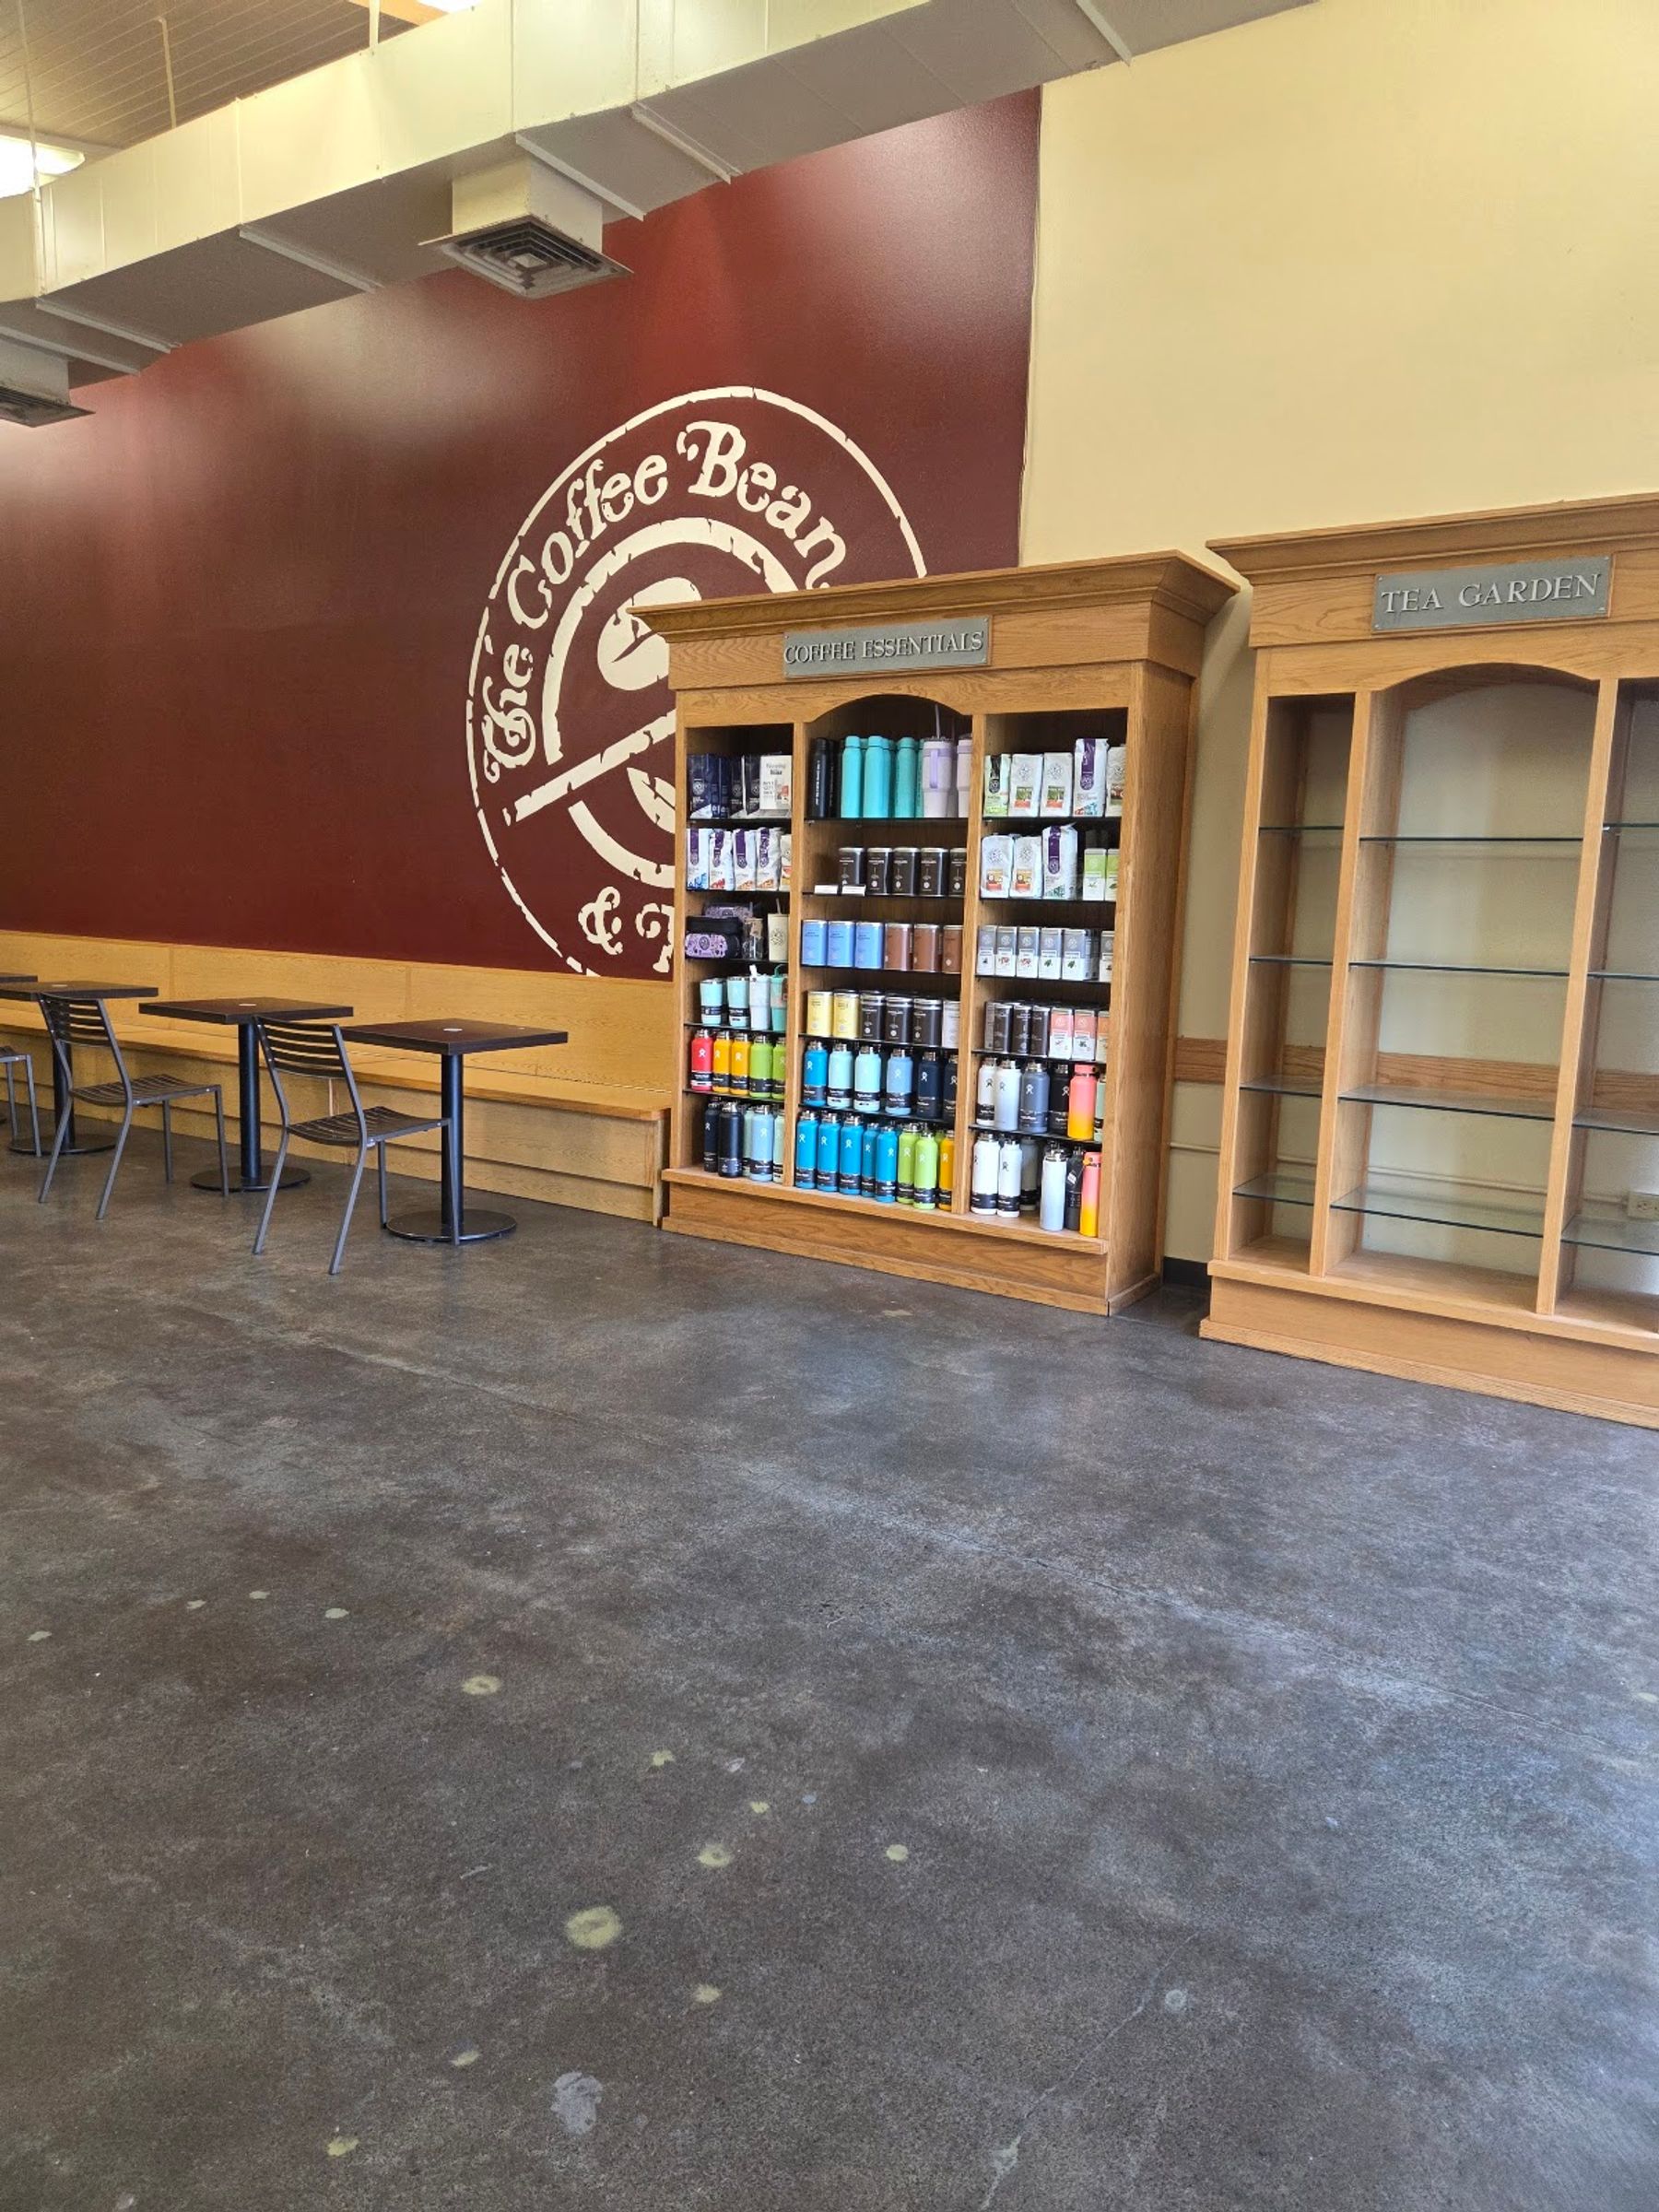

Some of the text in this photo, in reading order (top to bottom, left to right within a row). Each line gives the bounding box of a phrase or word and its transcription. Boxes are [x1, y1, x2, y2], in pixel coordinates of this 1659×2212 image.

[481, 420, 847, 783] The Coffee Bean
[1381, 572, 1602, 614] TEA GARDEN
[783, 630, 984, 665] COFFEE ESSENTIALS
[577, 886, 624, 956] &
